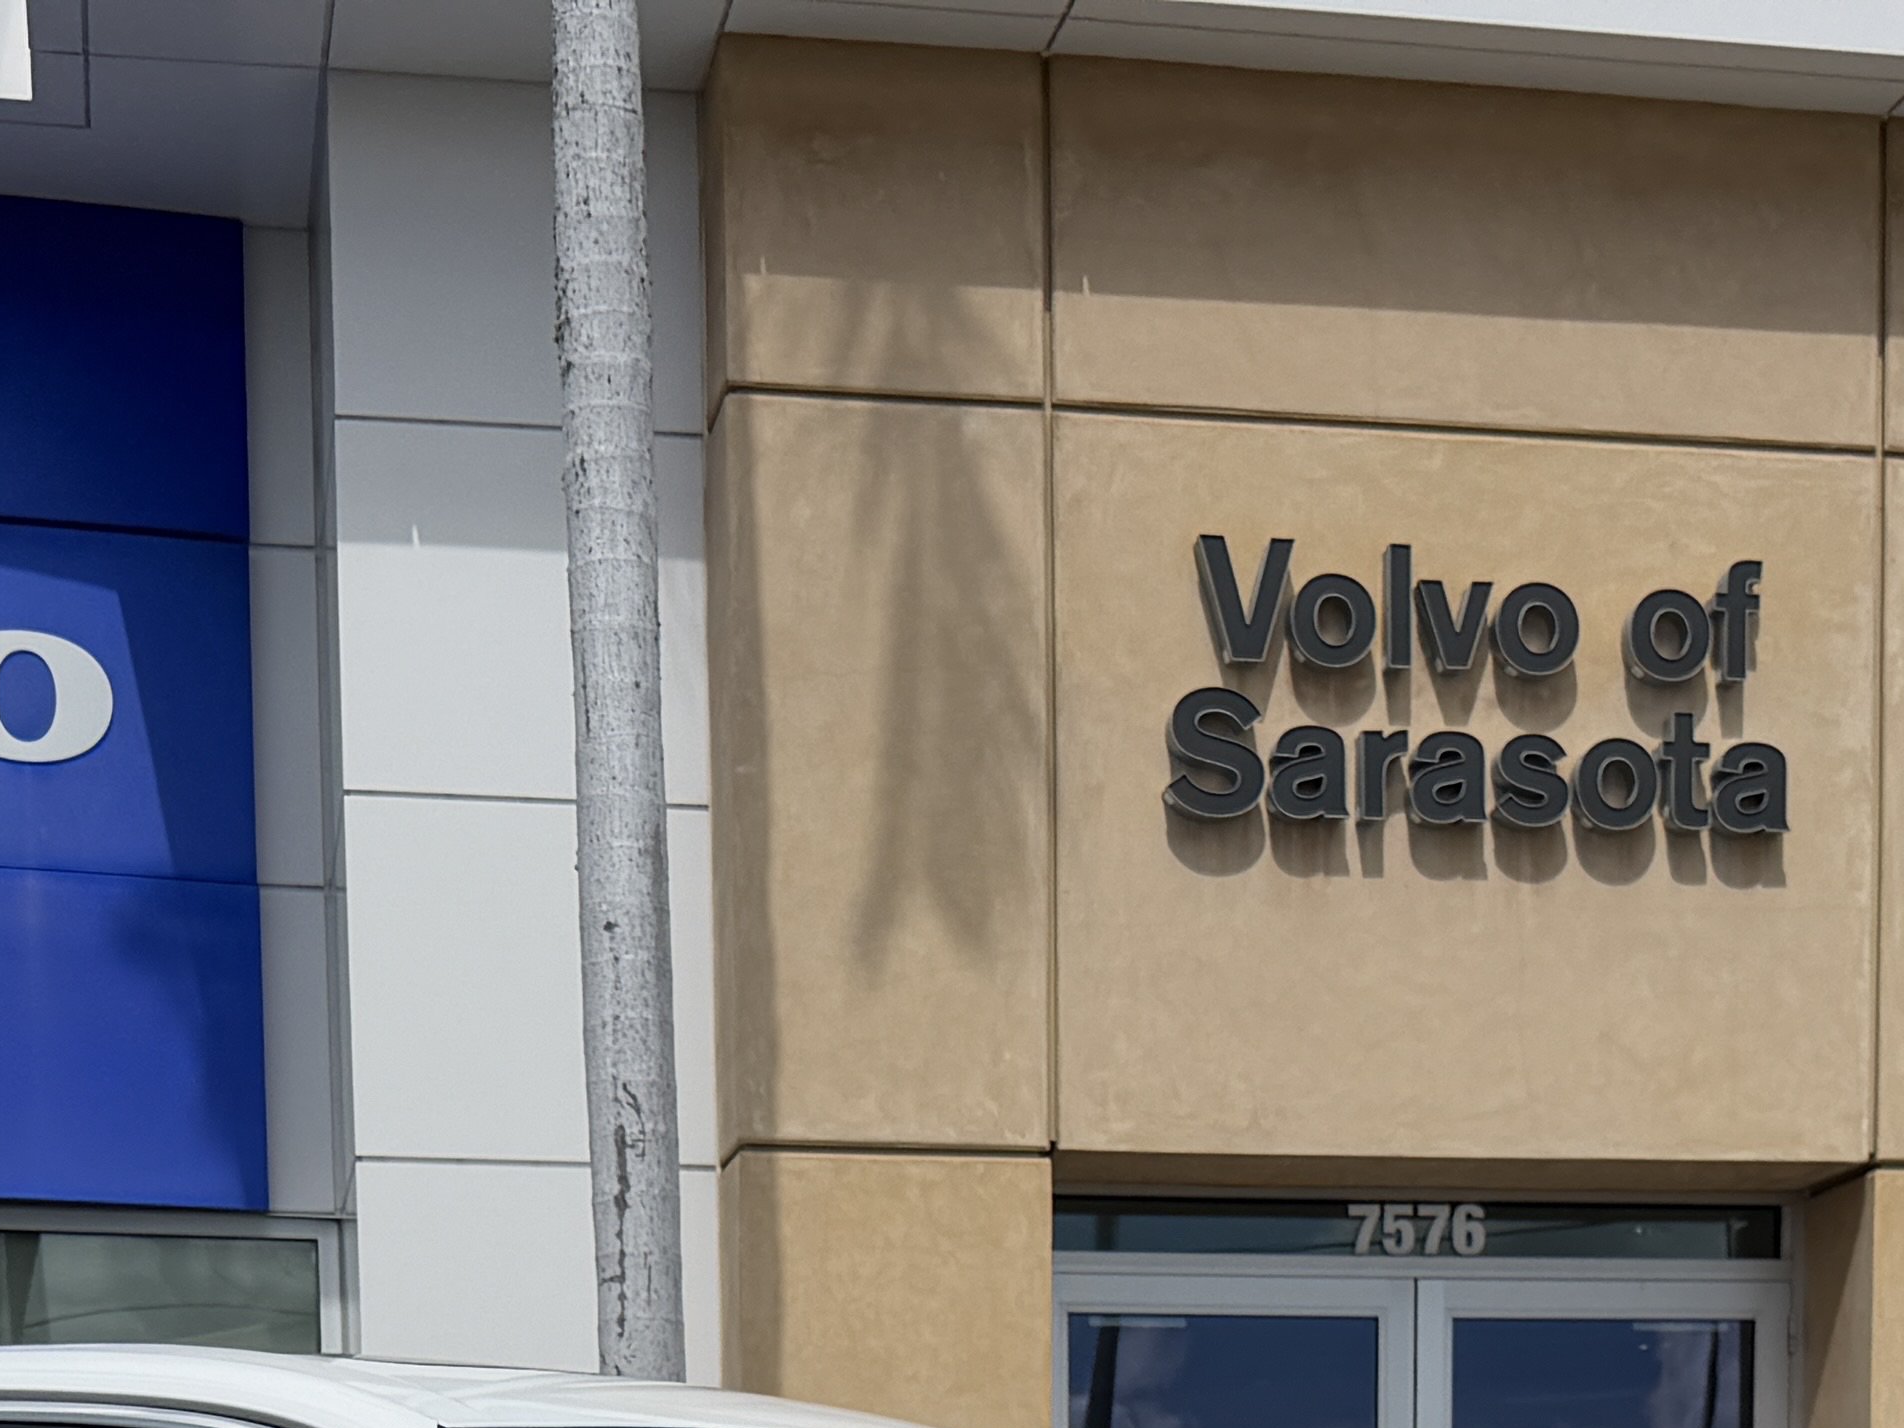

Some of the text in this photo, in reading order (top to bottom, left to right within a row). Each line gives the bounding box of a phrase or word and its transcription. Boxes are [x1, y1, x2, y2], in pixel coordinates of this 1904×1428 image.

[1194, 534, 1764, 684] Volvo of
[1163, 686, 1790, 835] Sarasota
[1347, 1203, 1487, 1256] 7576
